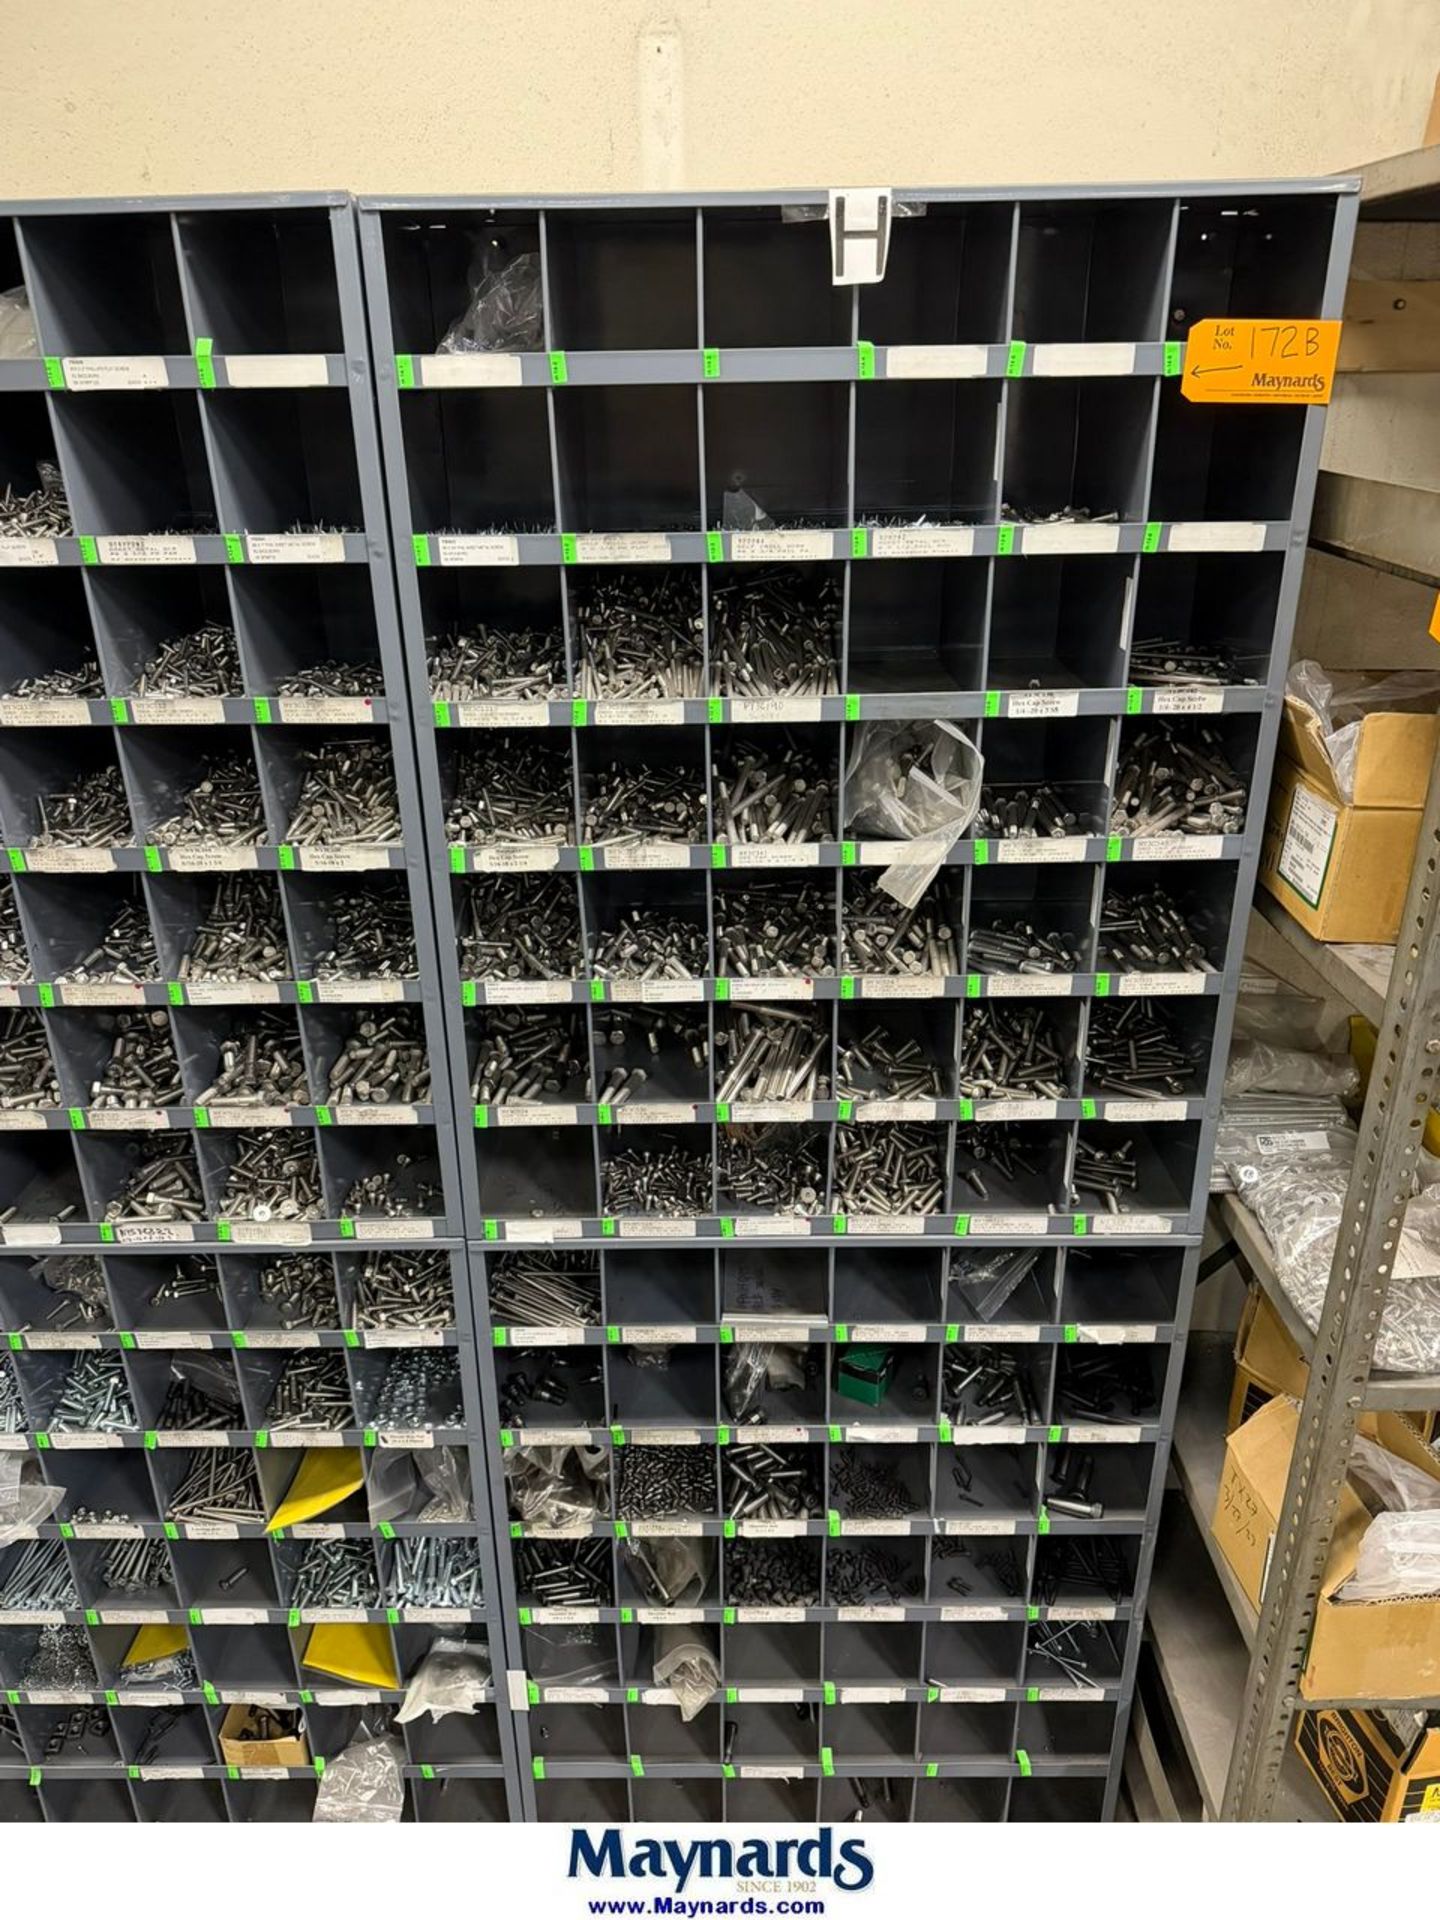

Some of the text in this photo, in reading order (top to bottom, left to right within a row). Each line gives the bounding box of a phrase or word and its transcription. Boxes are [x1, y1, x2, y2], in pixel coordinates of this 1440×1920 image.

[1215, 325, 1235, 337] Lot
[1213, 338, 1232, 350] No.
[1251, 373, 1325, 391] Maynards
[1331, 1712, 1363, 1757] BRIGHTON
